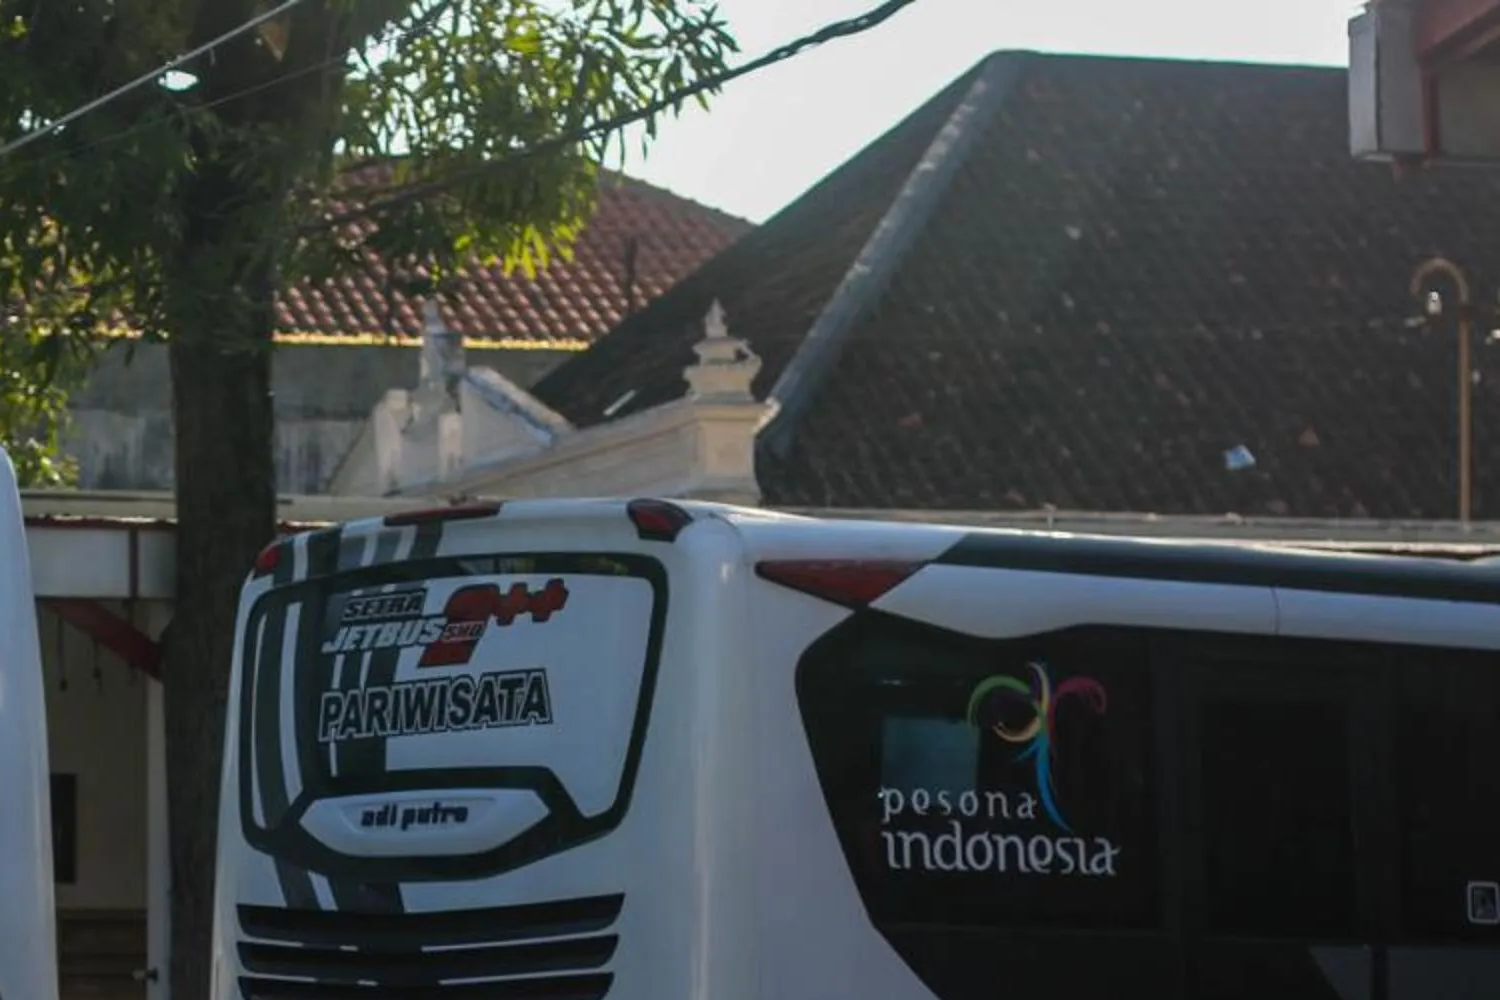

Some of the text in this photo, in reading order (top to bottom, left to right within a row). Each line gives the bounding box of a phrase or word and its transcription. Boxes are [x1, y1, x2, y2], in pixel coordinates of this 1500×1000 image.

[321, 617, 447, 654] JETBUS
[318, 667, 554, 743] PARIWISATA
[877, 785, 1037, 825] pesona
[880, 820, 1123, 877] indonesia
